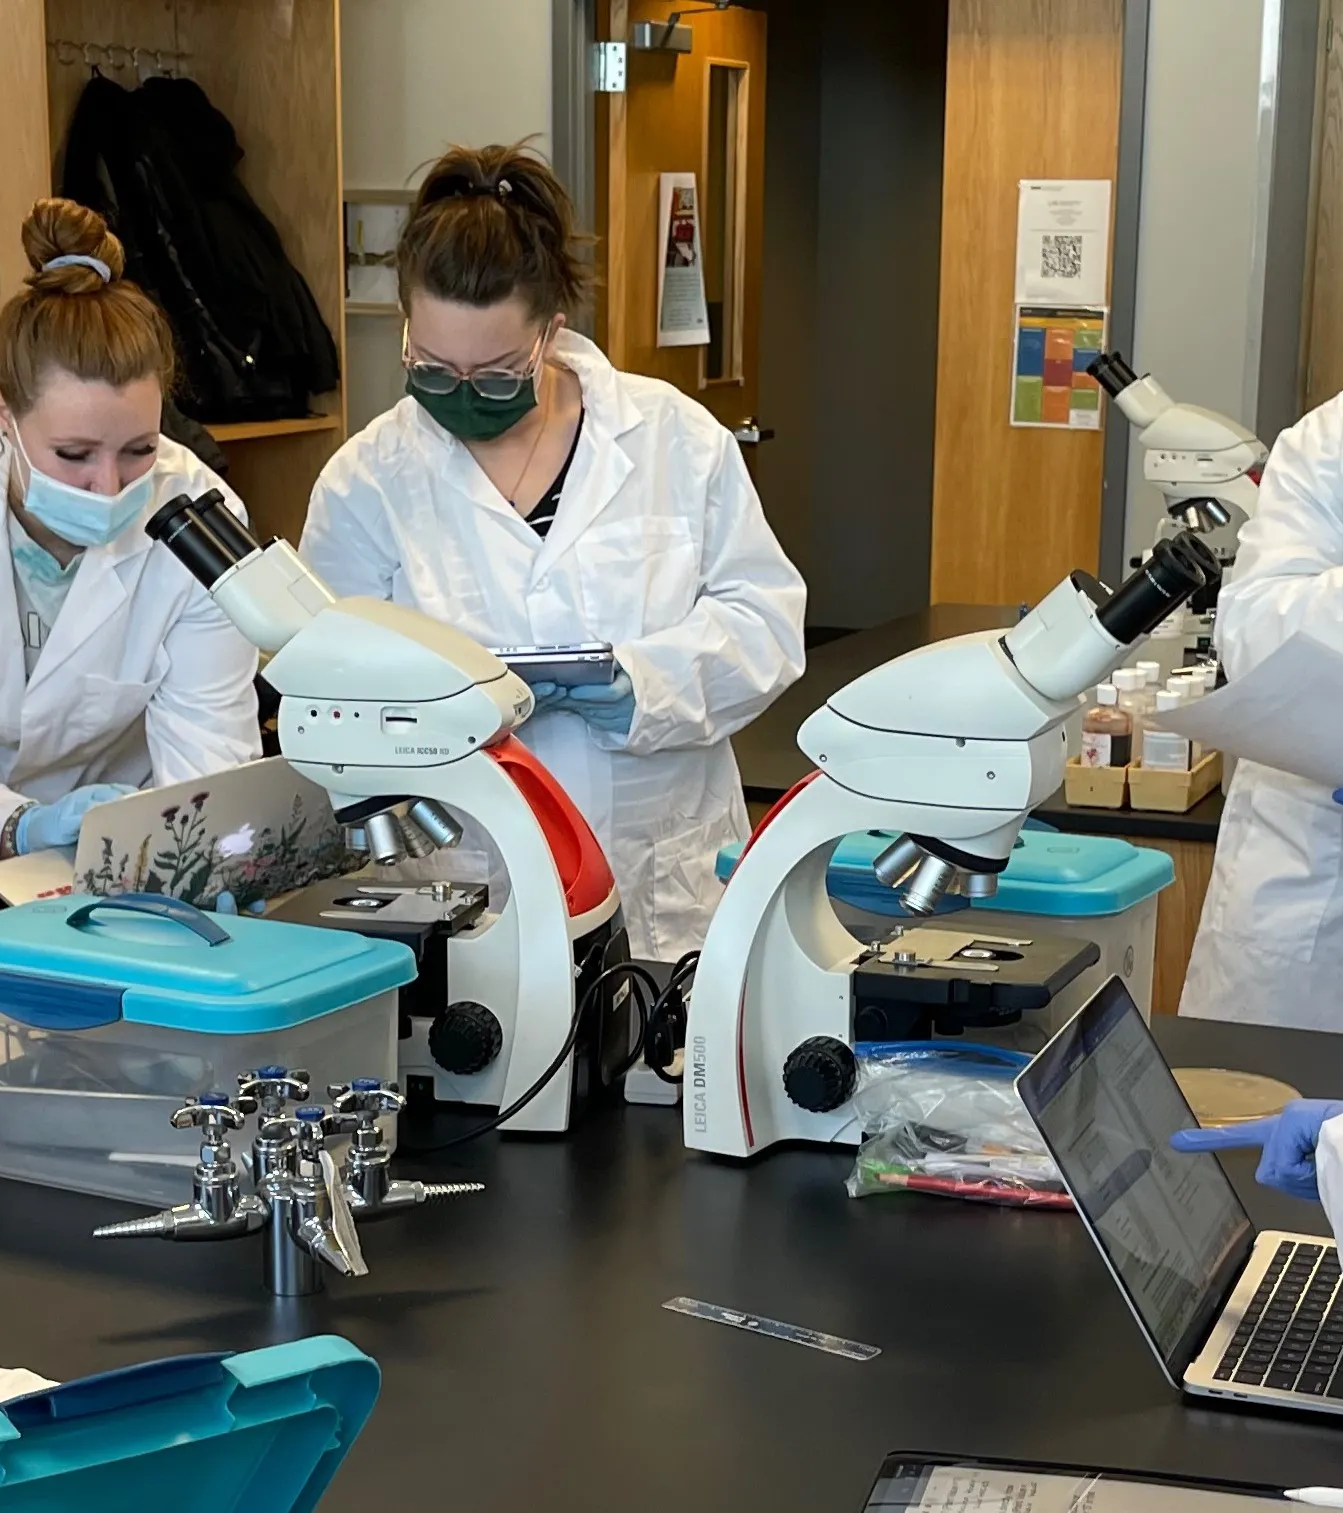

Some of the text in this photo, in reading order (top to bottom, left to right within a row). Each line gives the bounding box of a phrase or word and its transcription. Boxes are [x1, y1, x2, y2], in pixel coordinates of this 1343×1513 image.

[394, 745, 416, 755] LEICA
[693, 1035, 707, 1133] LEICA DM500
